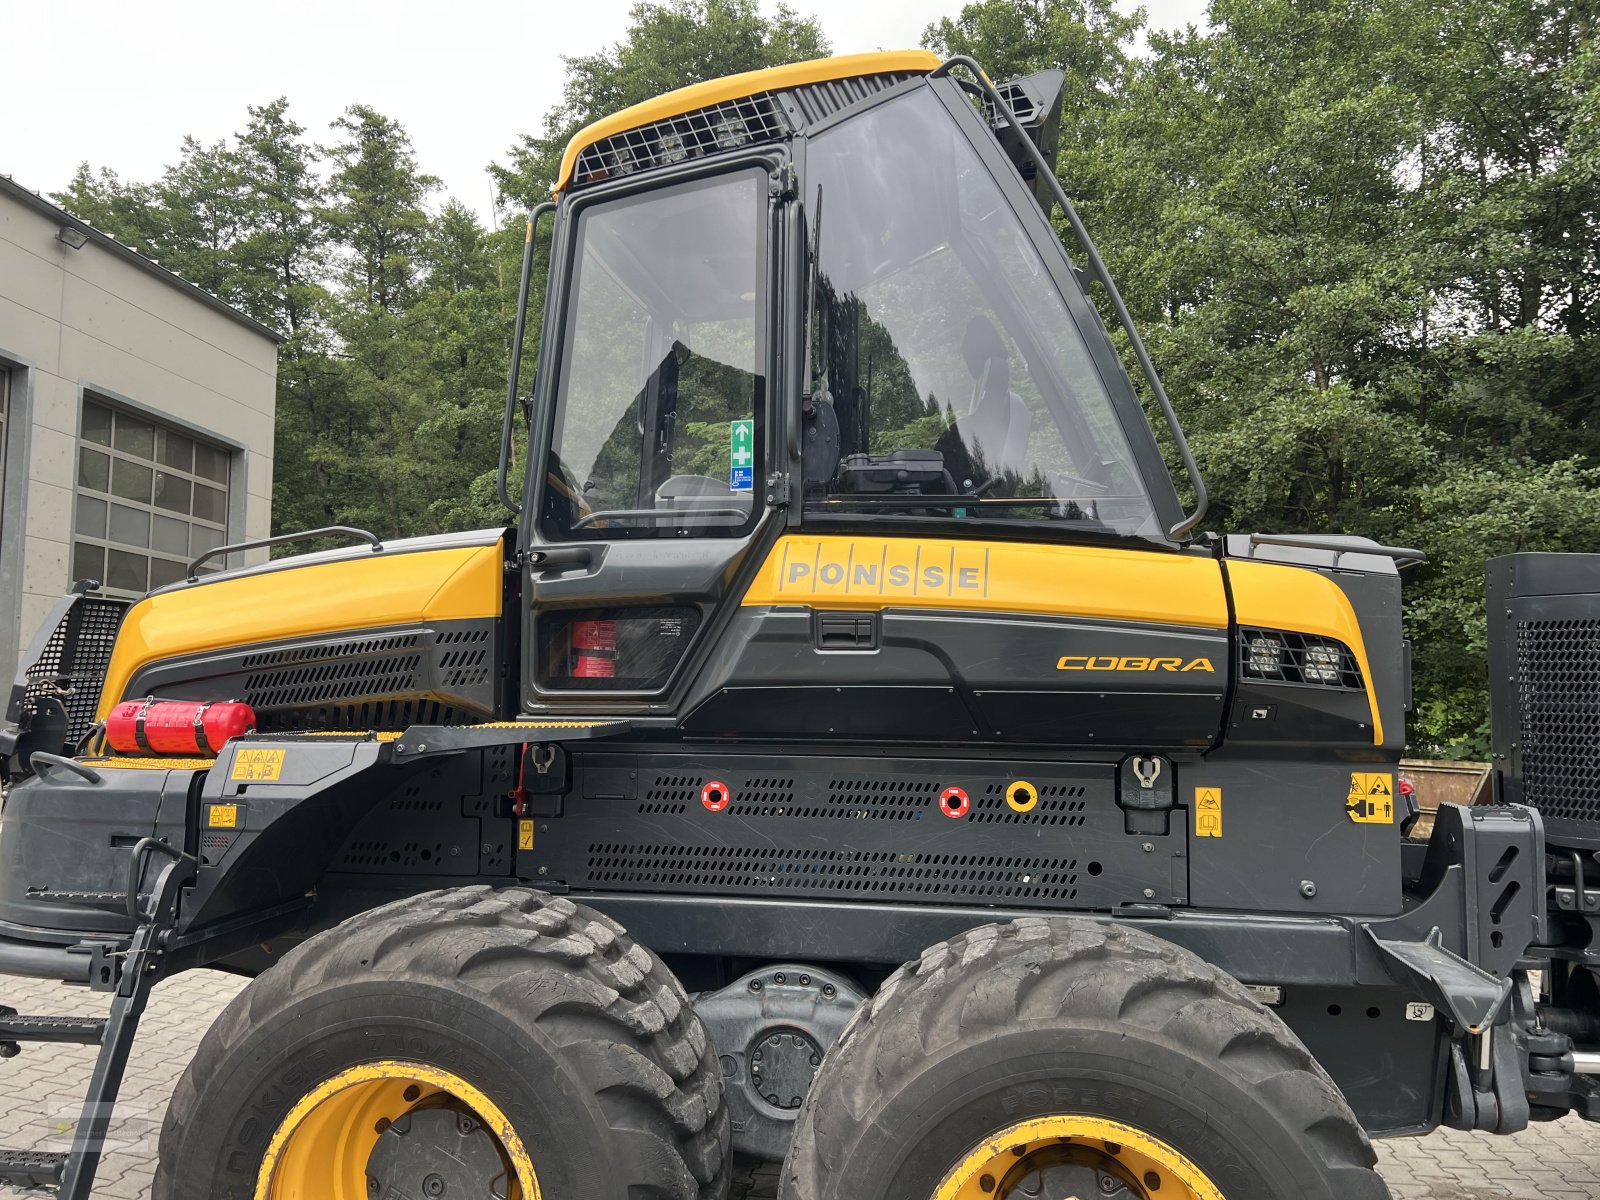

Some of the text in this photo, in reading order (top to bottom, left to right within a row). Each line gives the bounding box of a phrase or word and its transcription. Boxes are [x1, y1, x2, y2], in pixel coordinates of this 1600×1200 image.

[789, 562, 980, 588] PONSSE
[1056, 656, 1215, 672] COBRA
[999, 1086, 1147, 1116] FOREST
